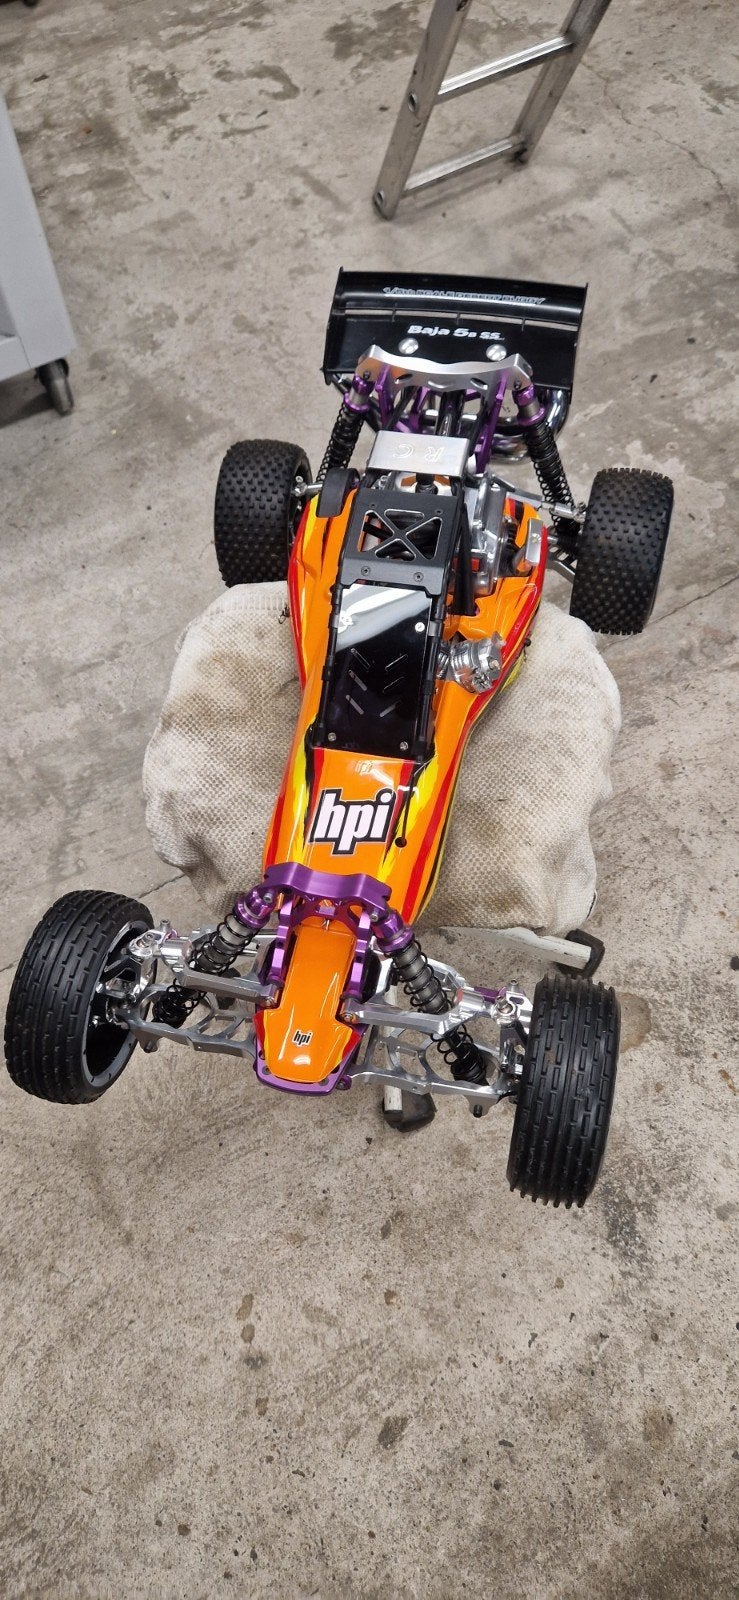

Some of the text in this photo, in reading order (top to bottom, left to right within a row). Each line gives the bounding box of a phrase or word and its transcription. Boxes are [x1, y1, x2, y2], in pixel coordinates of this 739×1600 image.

[407, 325, 450, 337] Baja
[310, 788, 396, 855] hpi
[293, 1030, 312, 1046] hpi
